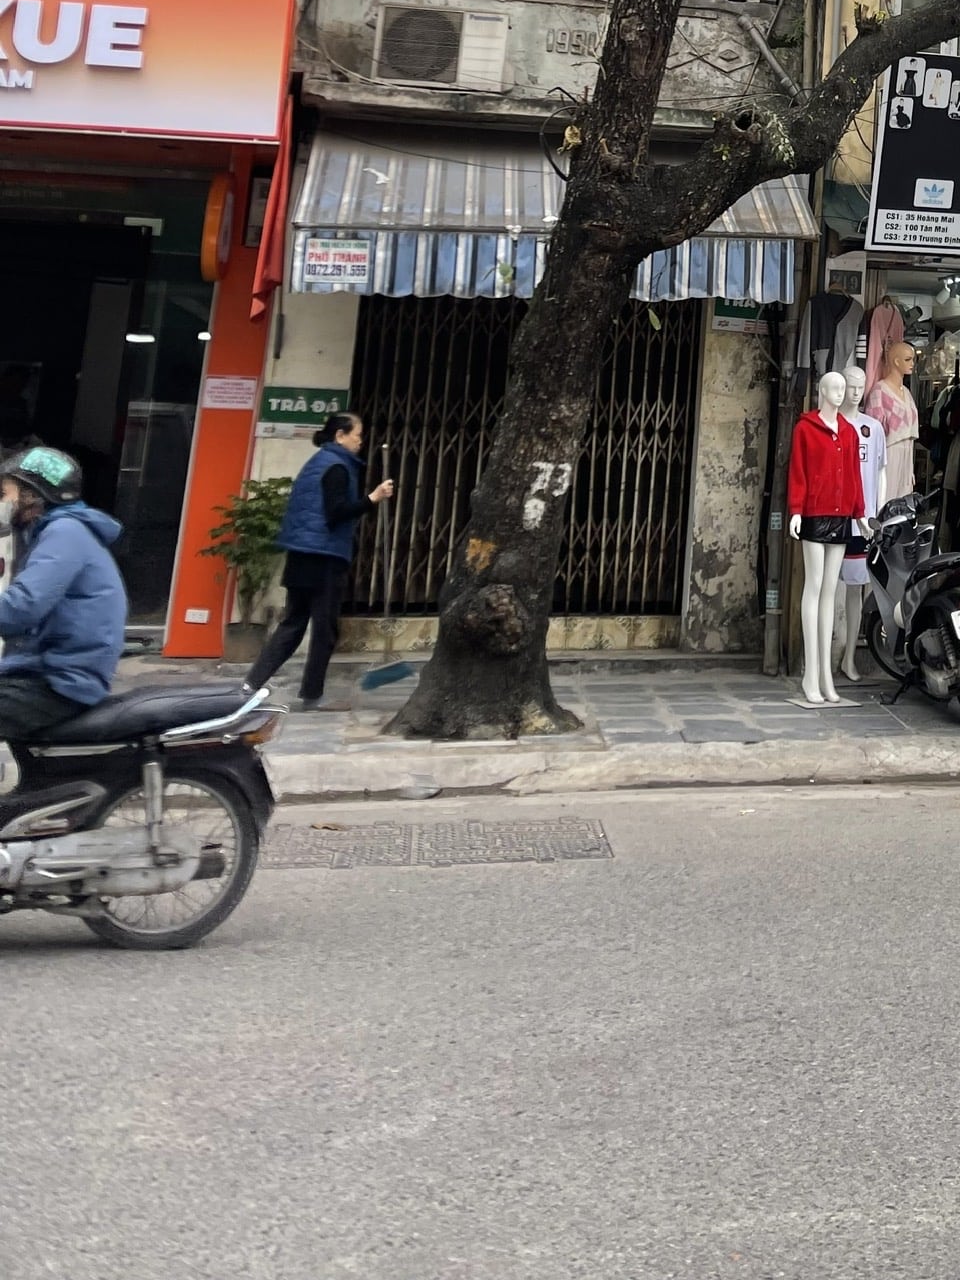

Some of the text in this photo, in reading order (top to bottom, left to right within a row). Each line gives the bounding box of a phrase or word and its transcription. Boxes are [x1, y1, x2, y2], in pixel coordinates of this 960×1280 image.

[903, 234, 918, 242] 219
[268, 396, 339, 413] TRÀ ĐÁ
